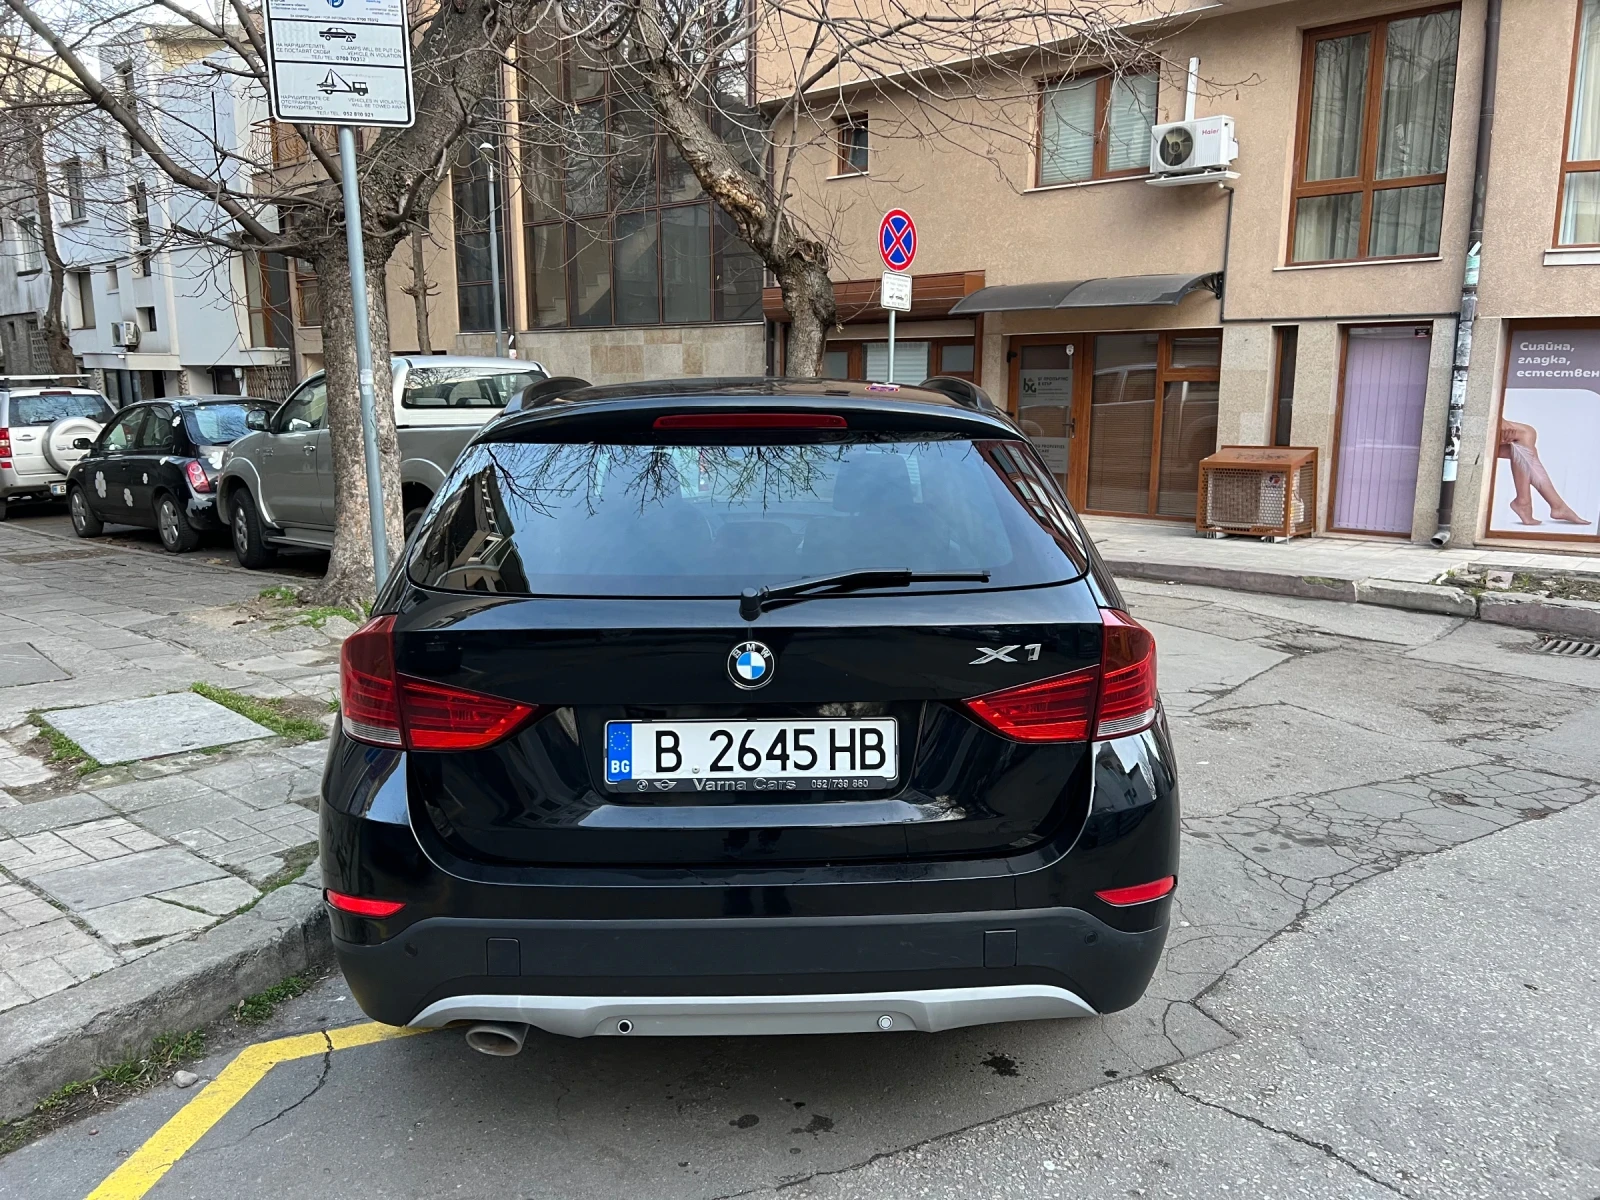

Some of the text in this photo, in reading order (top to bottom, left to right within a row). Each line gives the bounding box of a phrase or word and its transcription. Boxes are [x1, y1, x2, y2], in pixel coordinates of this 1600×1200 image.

[1520, 342, 1575, 352] Сияйна,
[1518, 355, 1571, 366] гладка,
[731, 643, 771, 659] BMW
[968, 643, 1042, 665] X1
[655, 728, 886, 773] B 2645 HB
[611, 760, 630, 774] BG
[692, 778, 747, 791] Varna
[753, 777, 797, 790] Cars
[811, 779, 849, 789] 052/739
